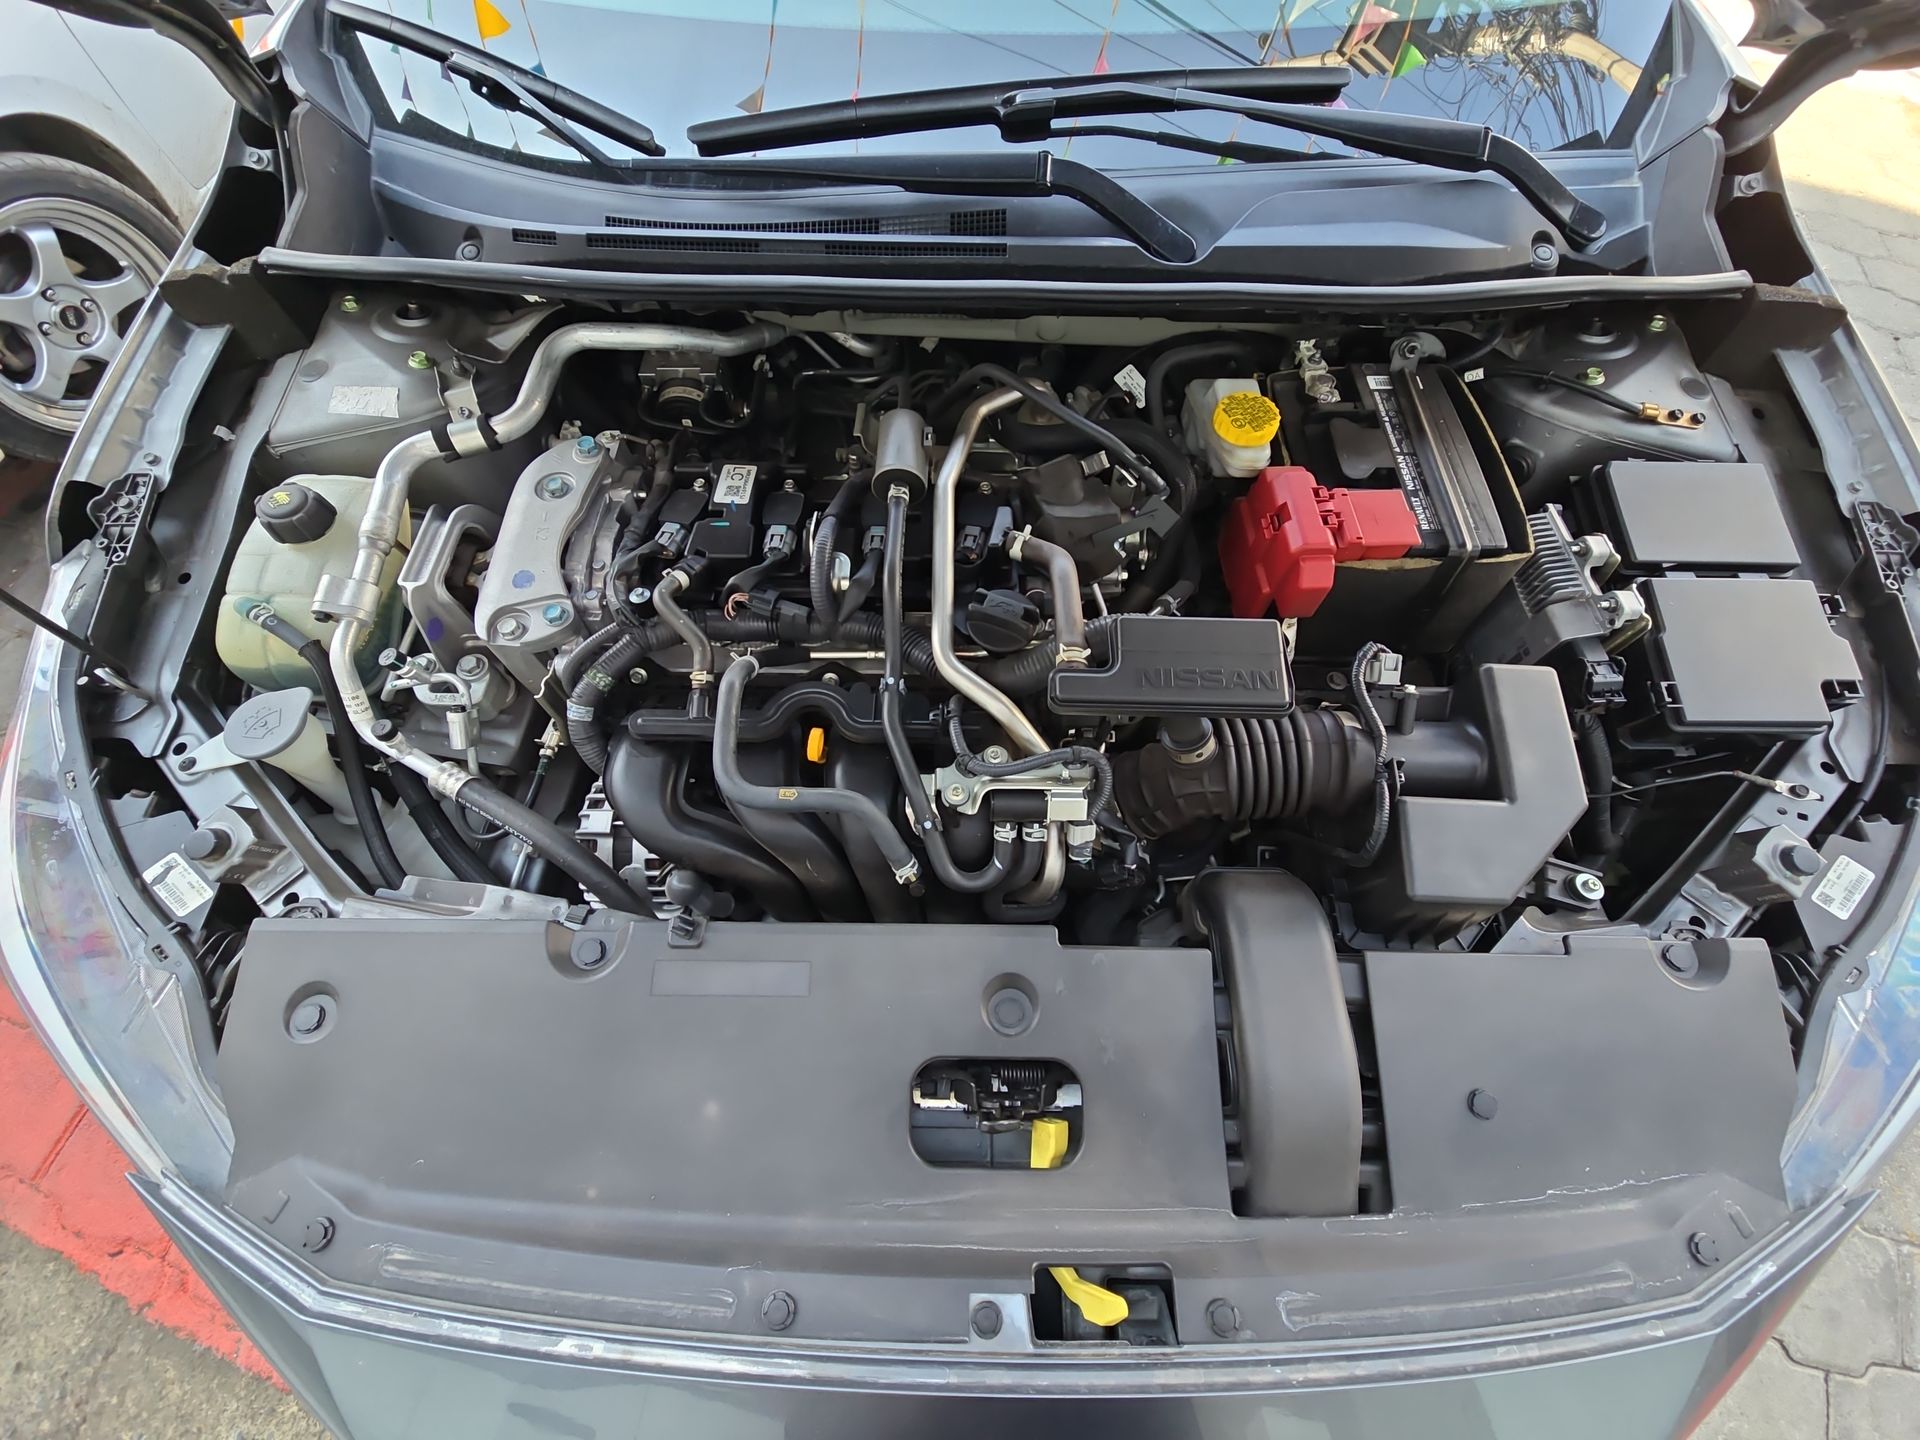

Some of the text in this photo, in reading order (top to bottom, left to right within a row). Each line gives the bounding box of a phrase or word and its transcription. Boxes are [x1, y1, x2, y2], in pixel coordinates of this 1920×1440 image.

[730, 466, 746, 481] LC
[1396, 455, 1416, 490] NISSAN
[1411, 496, 1430, 530] RENAULT
[1137, 666, 1280, 691] NISSAN
[503, 825, 533, 845] GALAXY
